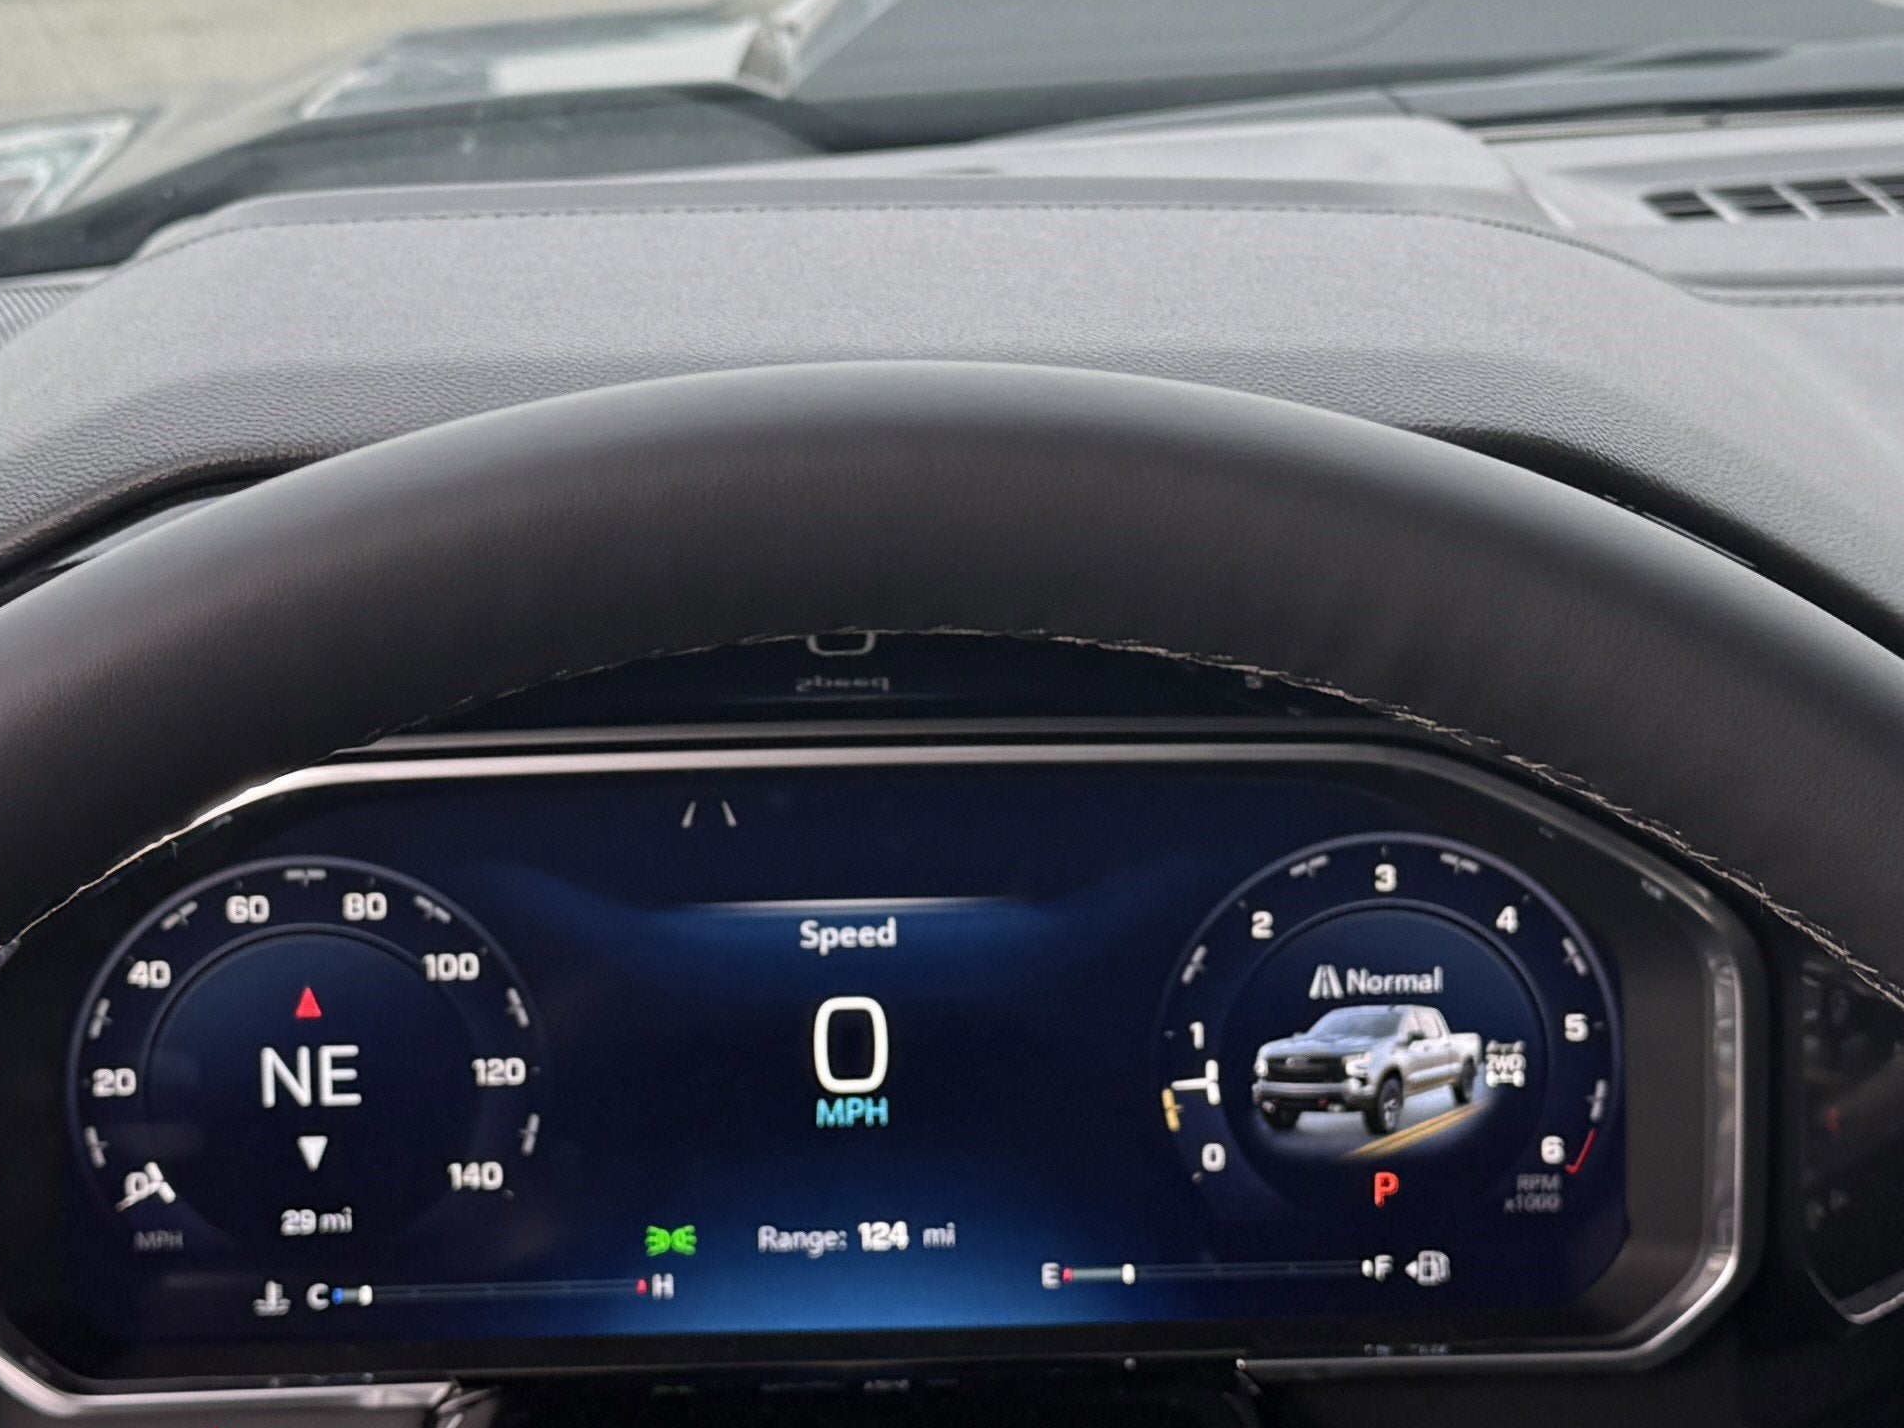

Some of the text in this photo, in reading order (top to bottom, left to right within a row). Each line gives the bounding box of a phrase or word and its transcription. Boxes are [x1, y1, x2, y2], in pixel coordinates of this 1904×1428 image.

[1374, 863, 1397, 892] 3
[225, 894, 270, 924] 60
[342, 892, 387, 922] 80
[1496, 906, 1519, 933] 4
[799, 916, 897, 956] Speed
[1251, 910, 1274, 940] 2
[126, 960, 171, 989] 40
[422, 952, 480, 982] 100
[1345, 966, 1444, 995] Normal
[1189, 1021, 1205, 1050] 1
[1564, 1012, 1589, 1043] 5
[813, 995, 889, 1095] 0
[92, 1067, 137, 1098] 20
[260, 1045, 362, 1109] NE
[471, 1057, 526, 1087] 120
[816, 1096, 889, 1128] MPH
[1201, 1142, 1226, 1172] 0
[1540, 1134, 1566, 1165] 6
[448, 1161, 503, 1191] 140
[1374, 1171, 1399, 1208] P
[280, 1206, 353, 1236] 29 mi
[133, 1230, 183, 1251] MPH
[758, 1220, 956, 1258] Range: 124 mi
[1041, 1261, 1061, 1290] E
[1374, 1254, 1394, 1282] F
[306, 1282, 330, 1311] C
[651, 1273, 675, 1300] H
